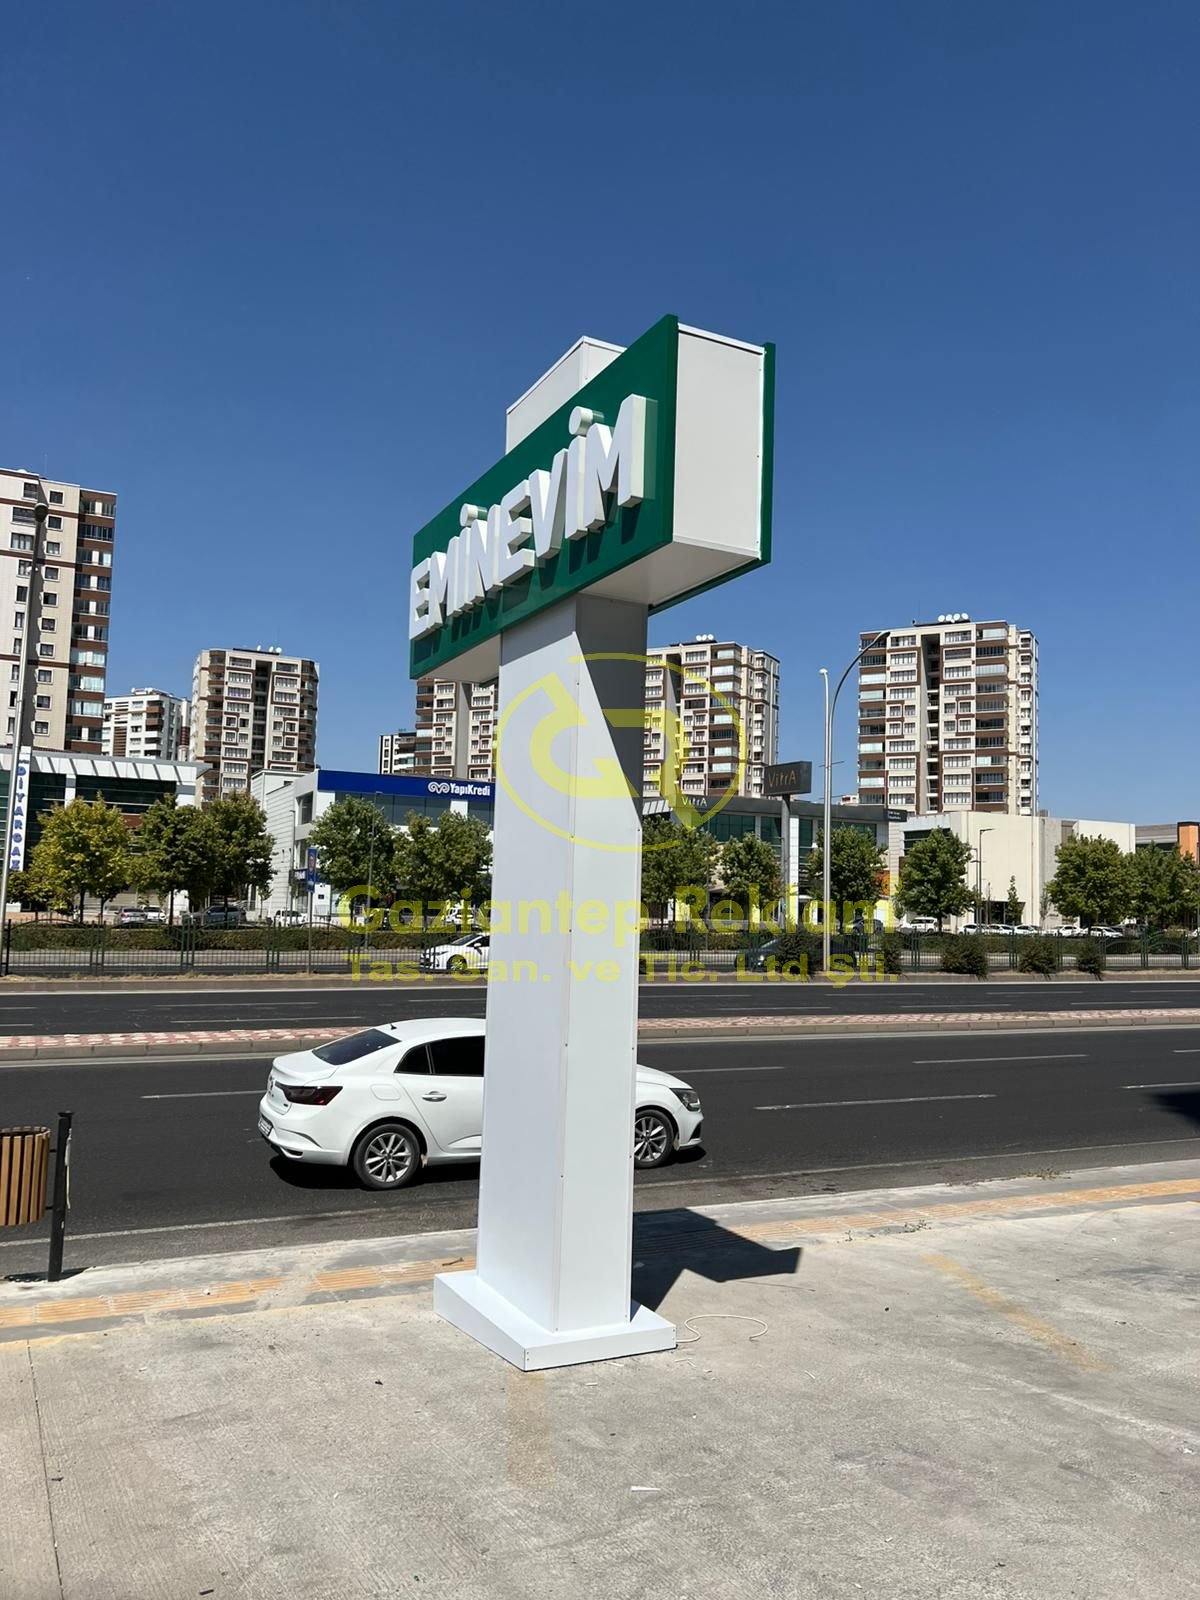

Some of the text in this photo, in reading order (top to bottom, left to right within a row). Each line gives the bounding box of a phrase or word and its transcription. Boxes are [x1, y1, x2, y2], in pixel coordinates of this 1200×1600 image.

[410, 394, 647, 640] EMİNEVİM
[768, 770, 798, 788] VitrA
[682, 796, 708, 808] VitrA
